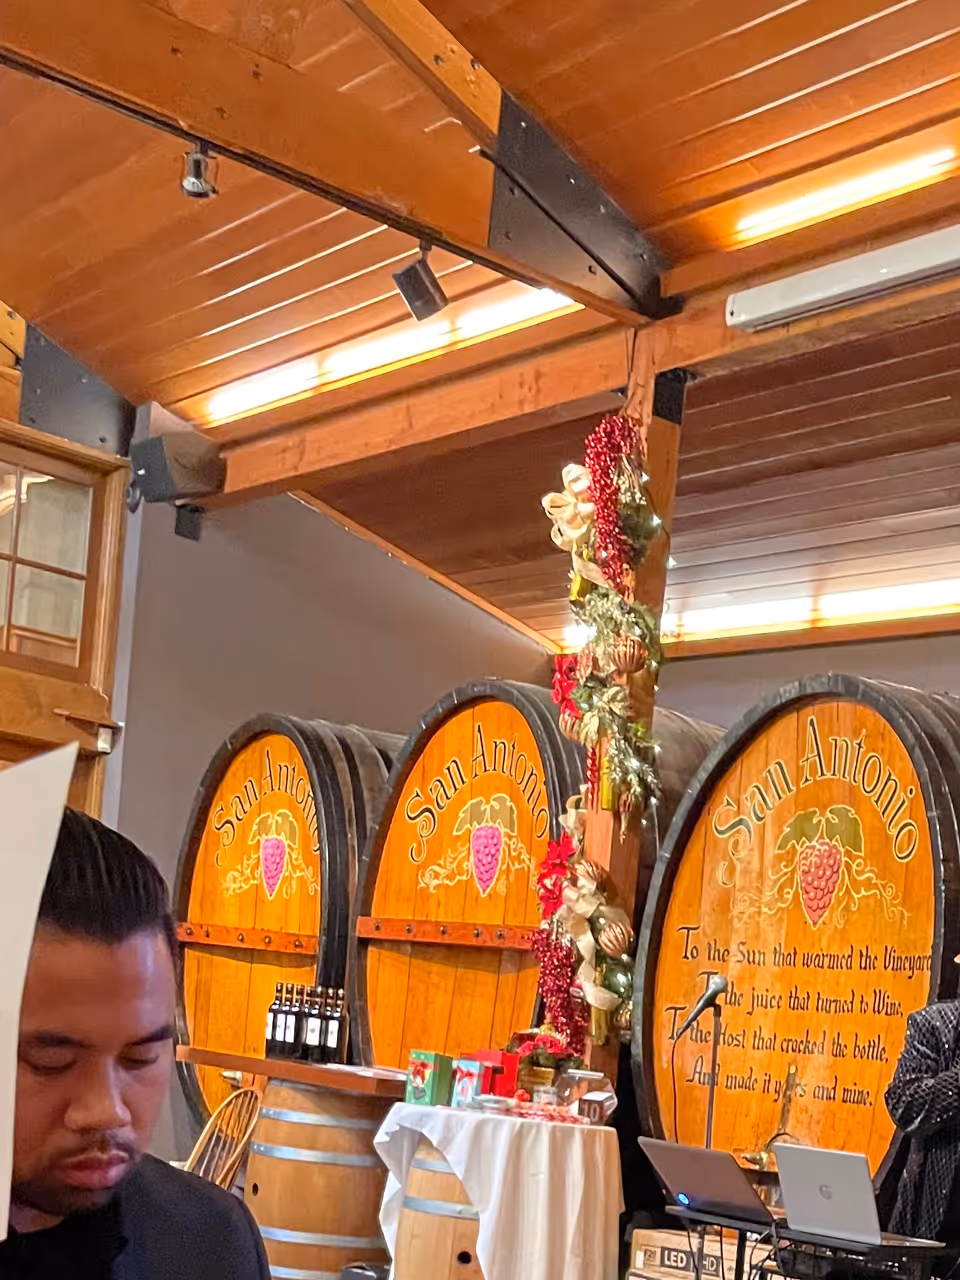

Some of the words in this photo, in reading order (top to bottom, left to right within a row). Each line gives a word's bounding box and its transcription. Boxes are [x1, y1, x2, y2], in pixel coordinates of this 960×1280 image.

[212, 777, 259, 868] San
[262, 748, 320, 853] Antoni
[405, 757, 467, 862] San
[472, 722, 550, 839] Antonio
[712, 760, 796, 887] San
[800, 715, 919, 862] Antonio
[677, 926, 699, 960] To
[707, 938, 730, 963] the
[736, 941, 766, 967] Sun
[773, 942, 798, 969] that
[802, 944, 854, 971] warmed
[859, 945, 878, 971] the
[725, 981, 744, 1007] the
[746, 987, 783, 1016] juice
[789, 985, 810, 1011] that
[816, 989, 856, 1014] turned
[860, 994, 869, 1015] to
[873, 989, 904, 1018] Wine,
[690, 1019, 712, 1044] the
[752, 1025, 777, 1051] that
[781, 1028, 826, 1055] cracked
[832, 1031, 848, 1058] the
[853, 1032, 889, 1064] bottle,
[725, 1066, 758, 1091] made
[763, 1073, 772, 1095] it
[813, 1075, 838, 1102] and
[842, 1082, 873, 1107] mine.
[664, 1250, 687, 1268] LED
